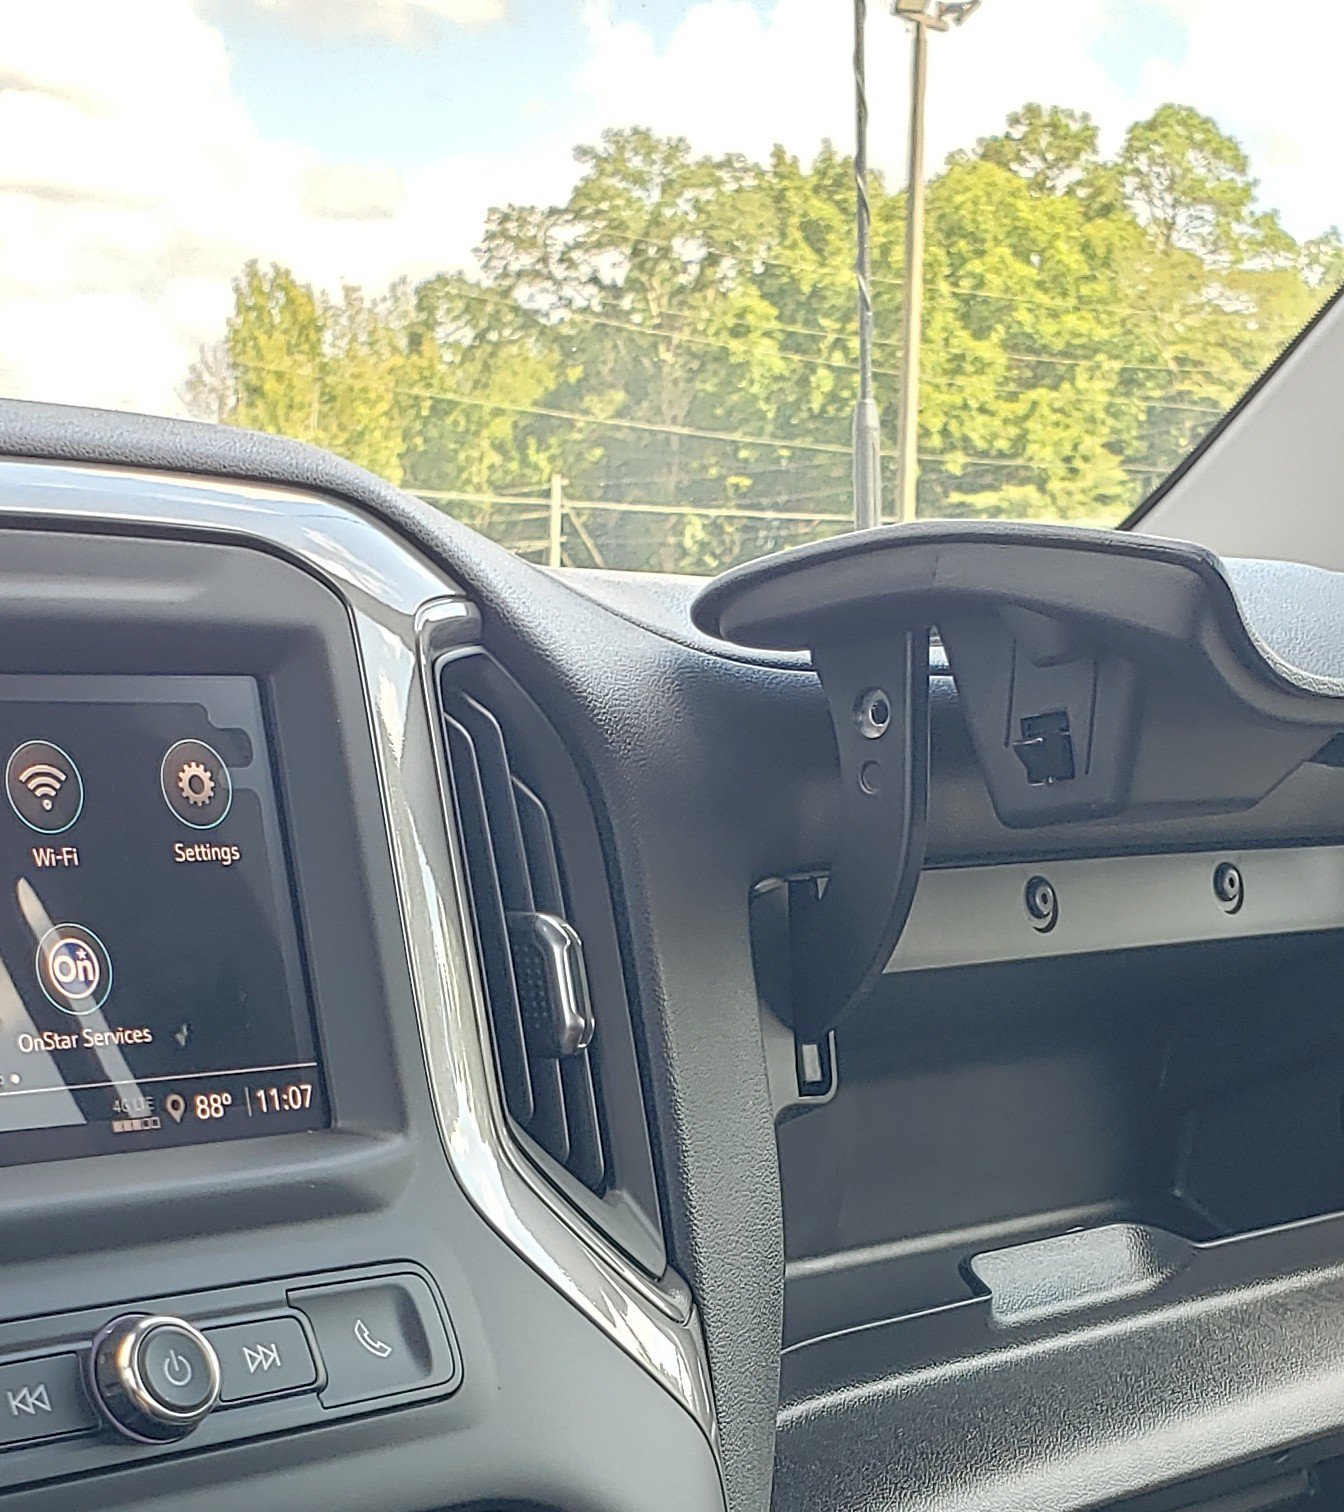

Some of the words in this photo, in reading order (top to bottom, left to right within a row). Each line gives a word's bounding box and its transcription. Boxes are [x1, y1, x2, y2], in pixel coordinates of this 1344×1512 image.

[32, 847, 79, 867] Wi-Fi
[174, 842, 241, 866] Settings
[18, 1030, 78, 1053] OnStar
[82, 1026, 153, 1049] Services
[256, 1084, 313, 1113] 11:07
